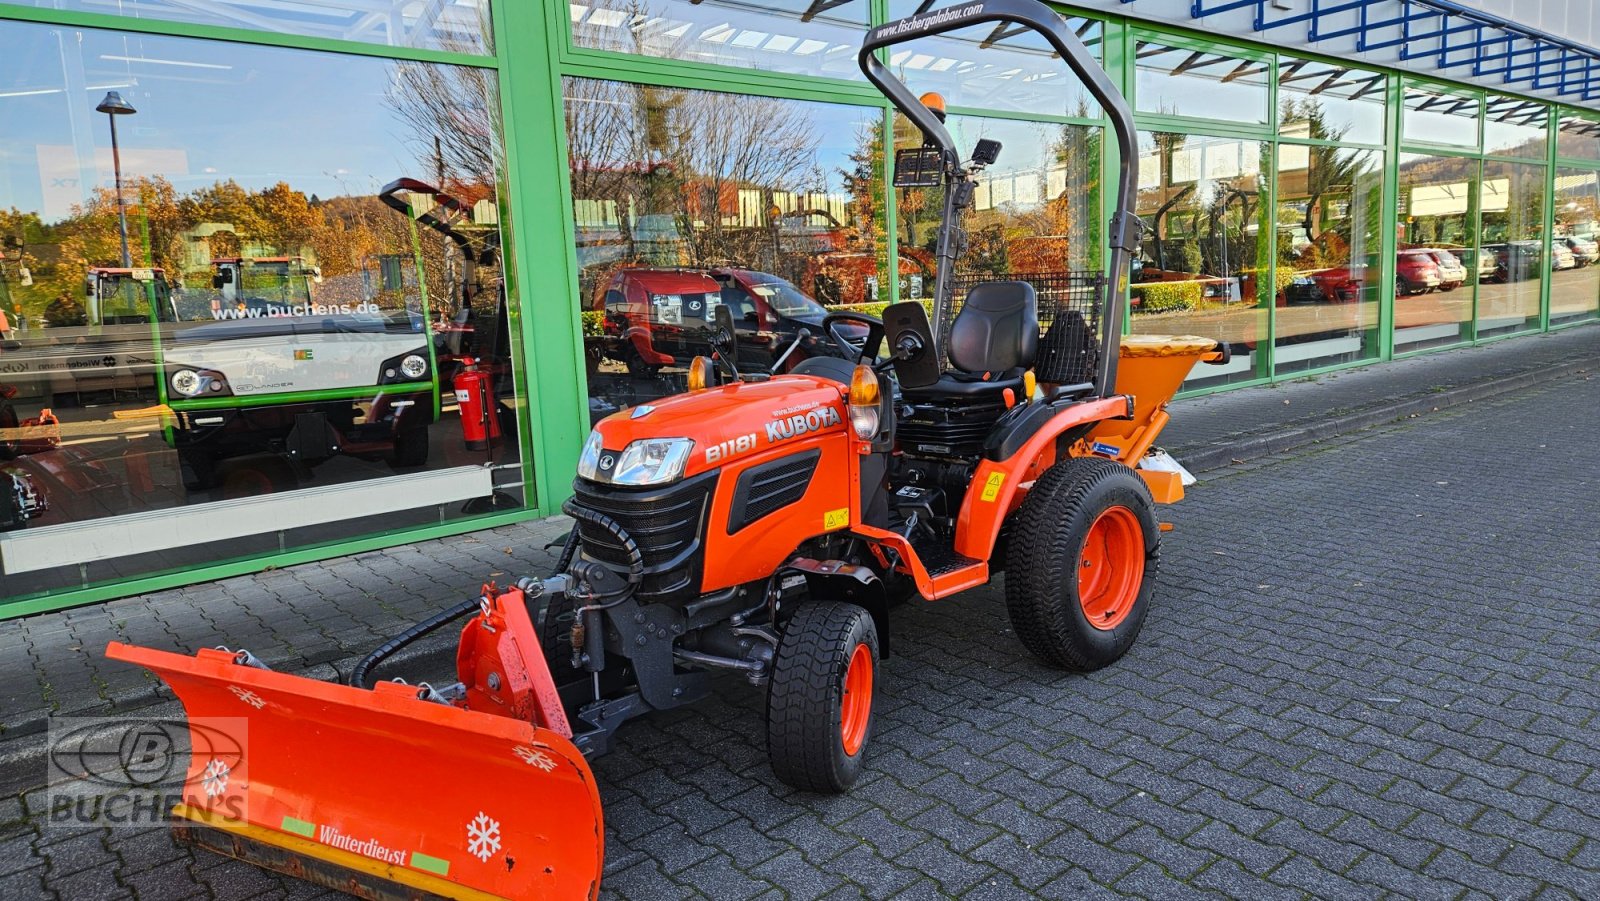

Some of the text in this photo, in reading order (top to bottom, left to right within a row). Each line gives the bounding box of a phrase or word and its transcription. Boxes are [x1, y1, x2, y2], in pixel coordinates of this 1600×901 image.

[877, 4, 984, 39] www.fischergalabau.com
[211, 301, 379, 320] www.buchens.de
[765, 407, 842, 443] KUBOTA
[705, 433, 757, 464] B1181
[320, 824, 407, 866] Winterdienst
